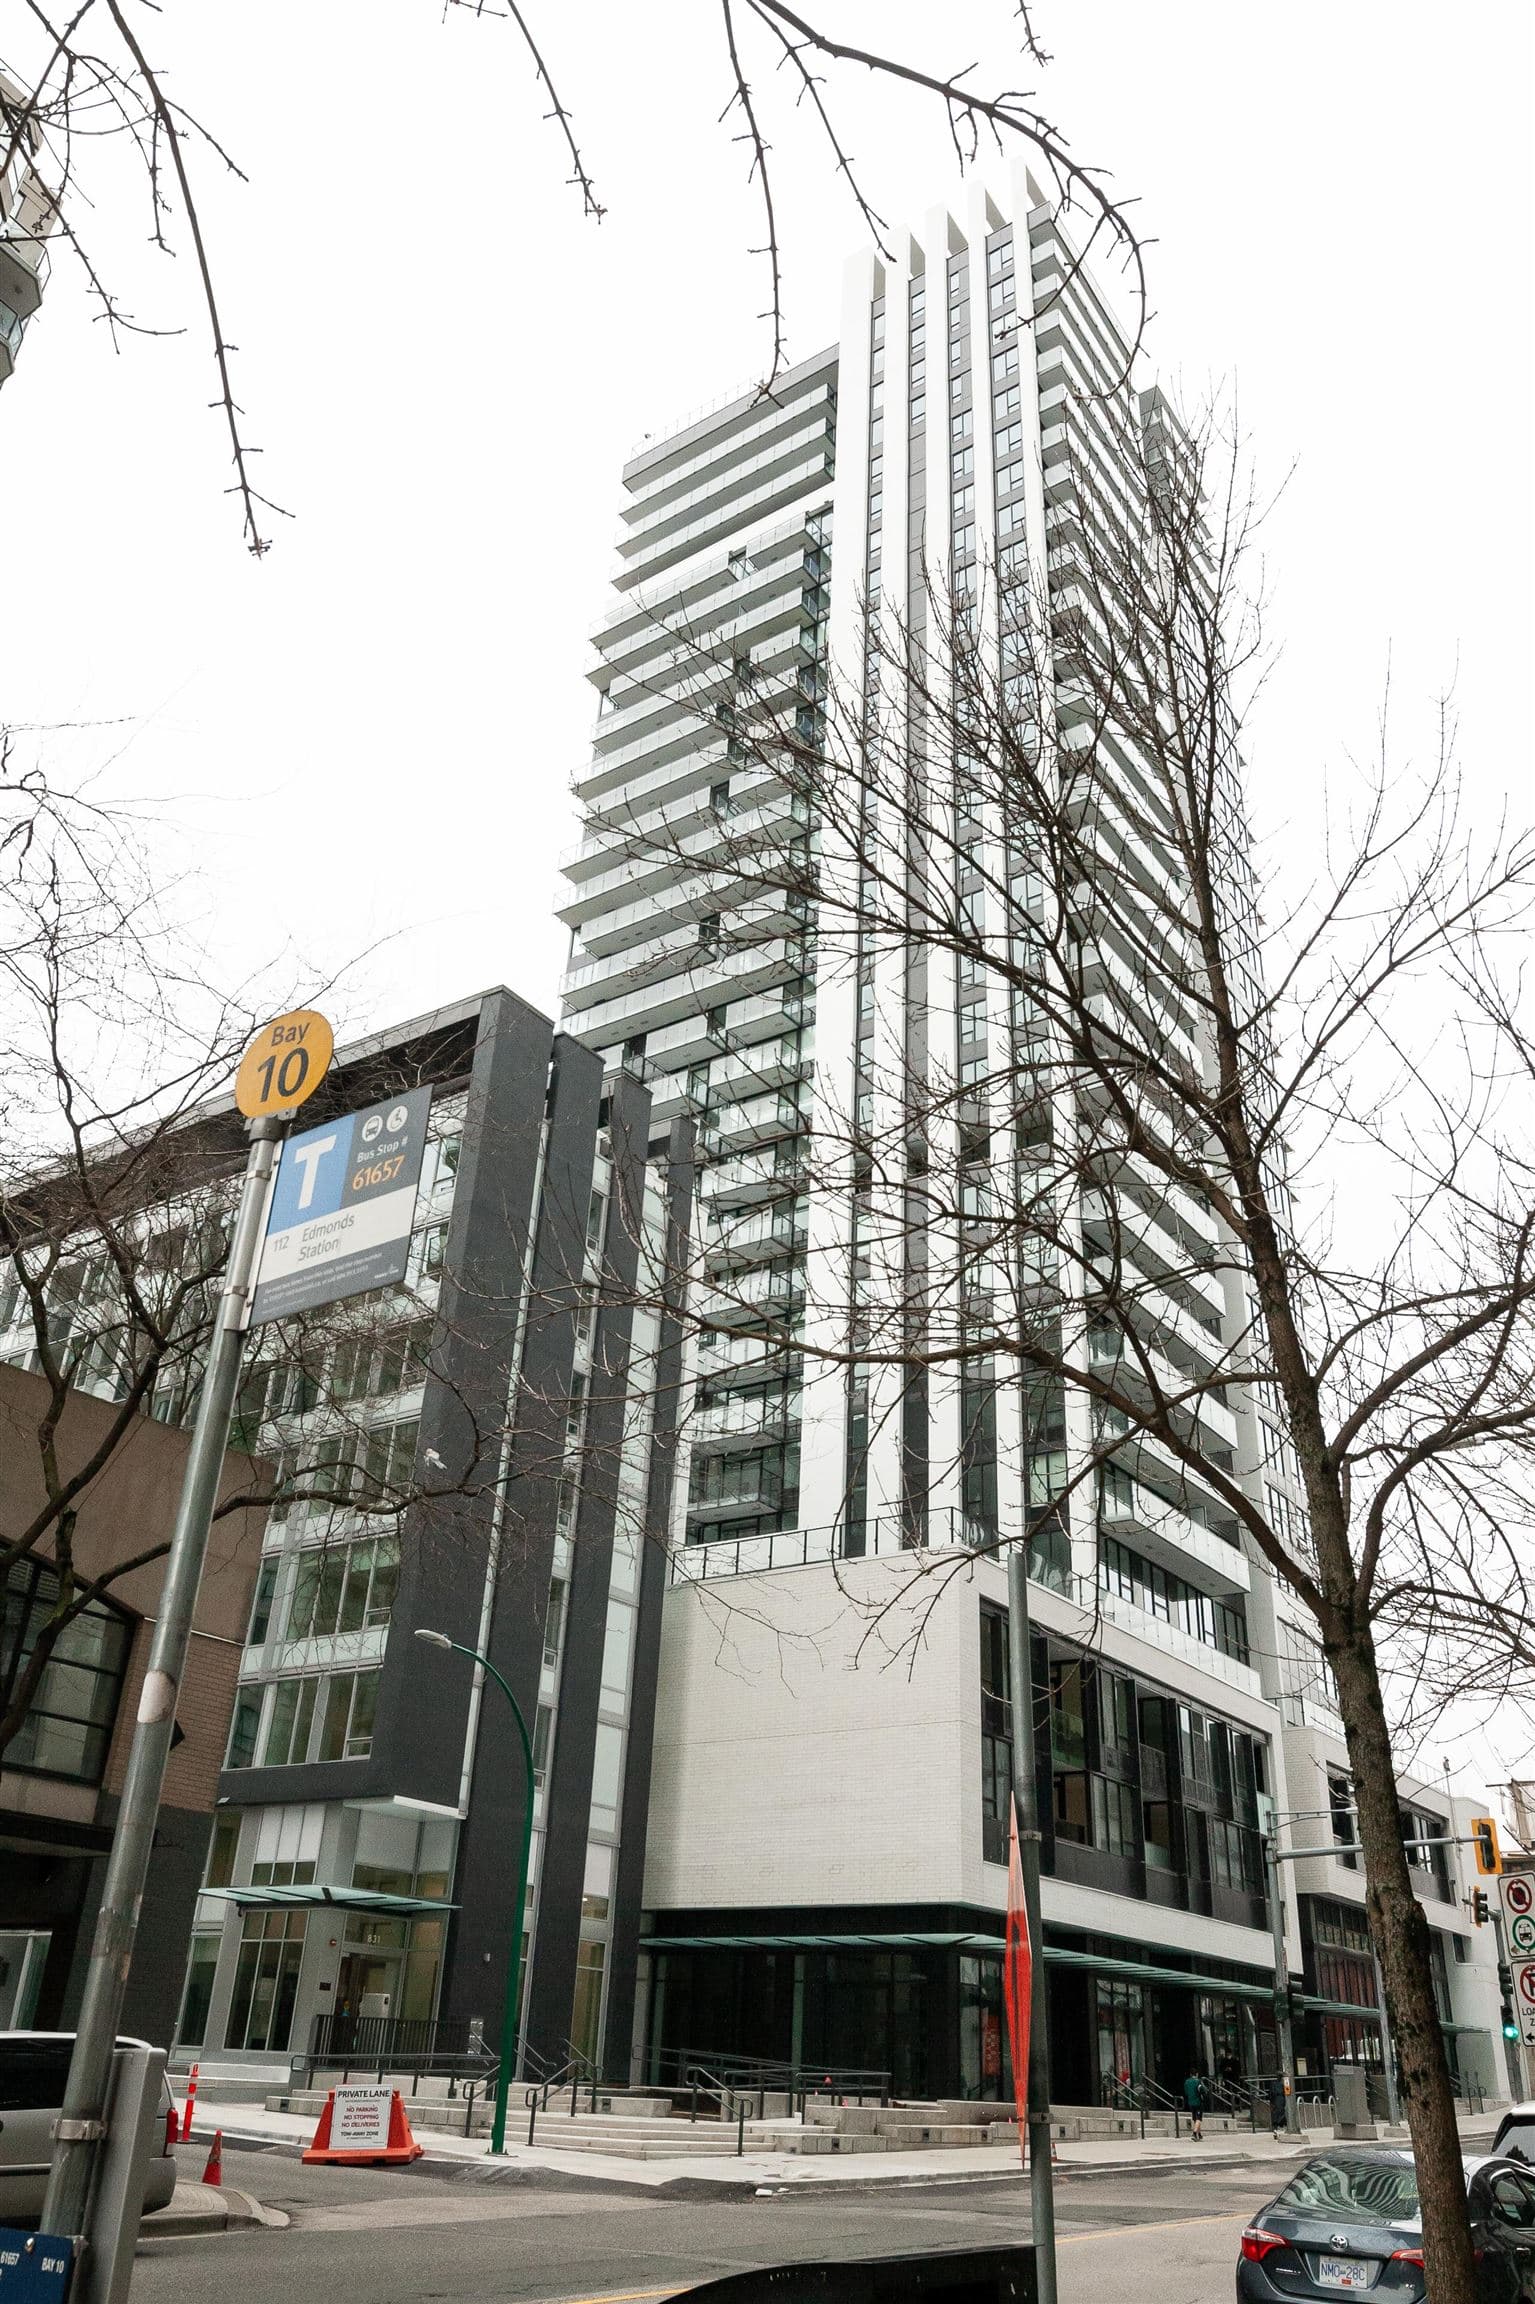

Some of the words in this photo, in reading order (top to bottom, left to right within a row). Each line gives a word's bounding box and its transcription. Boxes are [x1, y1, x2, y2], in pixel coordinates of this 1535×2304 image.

[271, 1022, 311, 1047] Bay
[257, 1047, 309, 1103] 10
[357, 1150, 375, 1163] Bus
[376, 1140, 399, 1156] Stop
[294, 1134, 336, 1210] T
[352, 1153, 406, 1191] 61657
[273, 1235, 290, 1253] 112
[302, 1213, 355, 1242] Edmonds
[299, 1238, 340, 1261] Station
[338, 2090, 368, 2098] PRIVATE
[370, 2090, 390, 2098] LANE
[41, 2257, 55, 2272] BAY
[56, 2260, 65, 2274] 10
